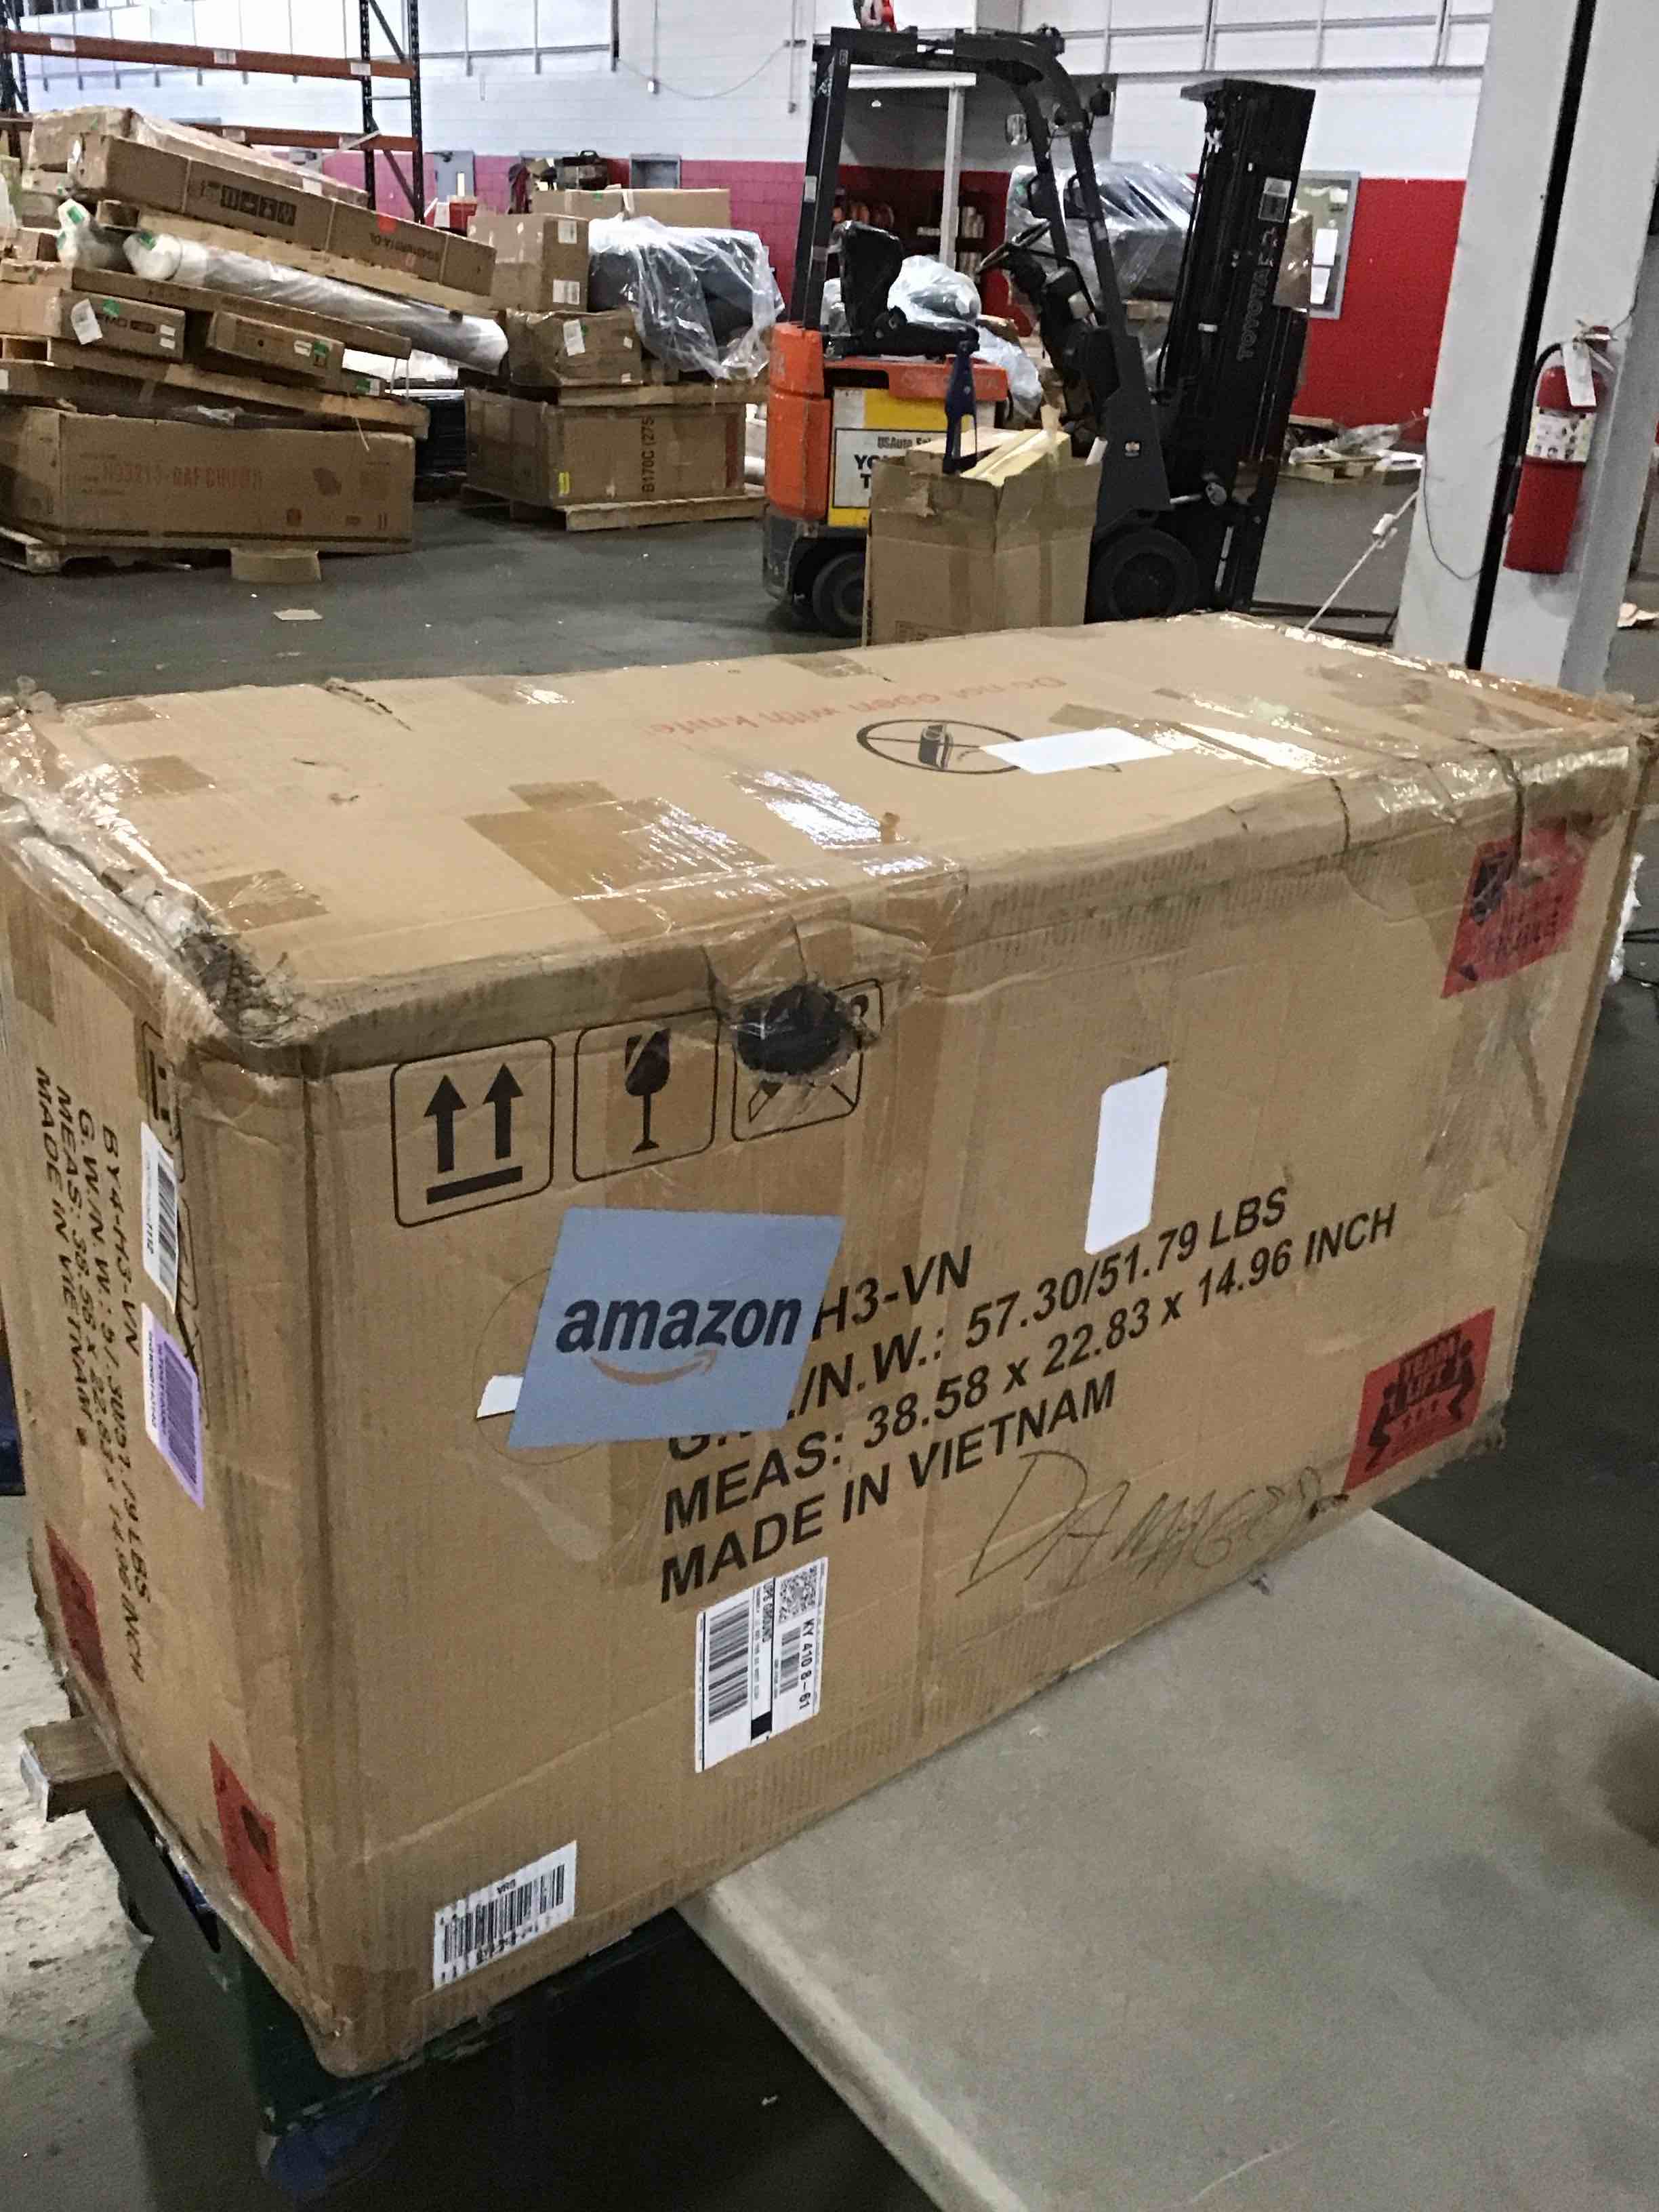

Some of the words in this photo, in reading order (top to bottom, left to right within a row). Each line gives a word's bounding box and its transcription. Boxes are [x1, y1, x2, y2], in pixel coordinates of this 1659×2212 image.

[1235, 269, 1270, 361] TOYOTA
[848, 693, 941, 712] open
[36, 1066, 63, 1193] MADE
[52, 1197, 70, 1243] IN
[103, 1124, 140, 1356] BY4-H3-VN
[965, 1220, 1199, 1350] 57.30/51.79
[1209, 1186, 1288, 1249] LBS
[57, 1085, 83, 1220] MEAS:
[72, 1229, 98, 1331] 38.58
[89, 1366, 115, 1465] 22.83
[121, 1593, 145, 1683] INCH
[58, 1254, 94, 1423] VIETNAM
[555, 1298, 802, 1353] amazon
[664, 1429, 845, 1536] MEAS:
[863, 1364, 990, 1449] 38.58
[1003, 1356, 1030, 1394] x
[1042, 1297, 1151, 1377] 22.83
[1160, 1290, 1184, 1328] x
[1198, 1238, 1292, 1309] 14.96
[1304, 1202, 1398, 1267] INCH
[661, 1493, 826, 1604] MADE
[842, 1463, 891, 1525] IN
[909, 1369, 1118, 1490] VIETNAM
[128, 1528, 151, 1603] LBS
[803, 1618, 815, 1637] KY
